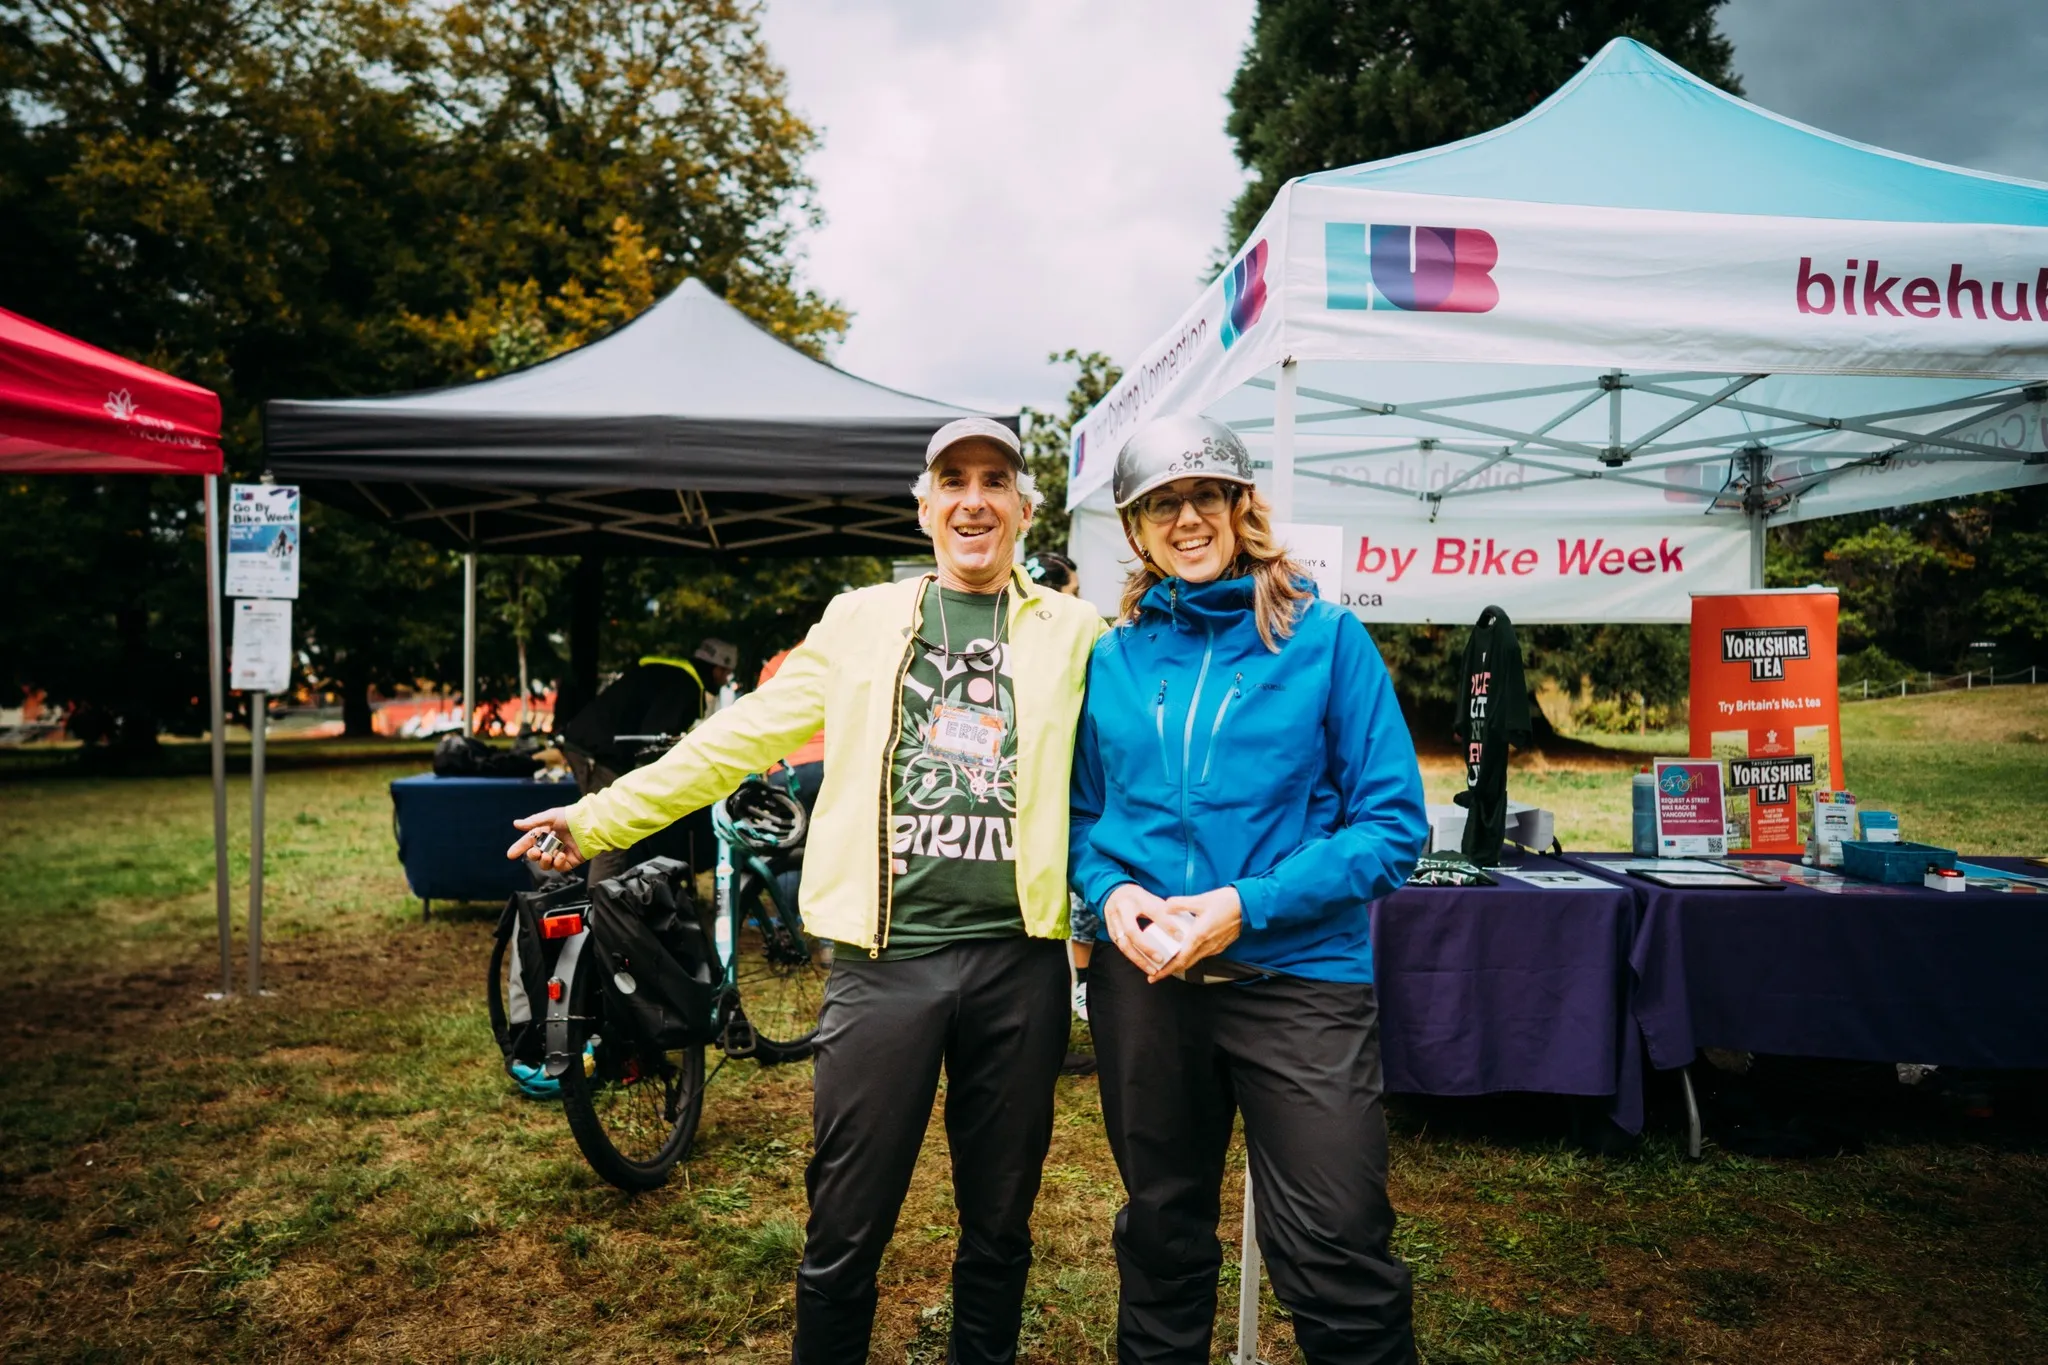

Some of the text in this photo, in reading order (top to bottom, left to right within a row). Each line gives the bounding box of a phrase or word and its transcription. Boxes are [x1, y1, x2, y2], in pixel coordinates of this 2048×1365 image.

[1325, 222, 1500, 314] HUB
[233, 503, 270, 514] Go By
[233, 512, 295, 523] Bike Week
[1356, 536, 1685, 582] by Bike Week
[1725, 634, 1807, 658] YORKSHIRE
[1754, 657, 1783, 677] TEA
[1718, 697, 1821, 715] Try Britain's No.1 tea
[945, 720, 989, 745] ERIC
[1733, 763, 1812, 786] YORKSHIRE
[1661, 797, 1685, 805] REQUEST
[1759, 784, 1787, 802] TEA
[891, 814, 1017, 861] BIKIN
